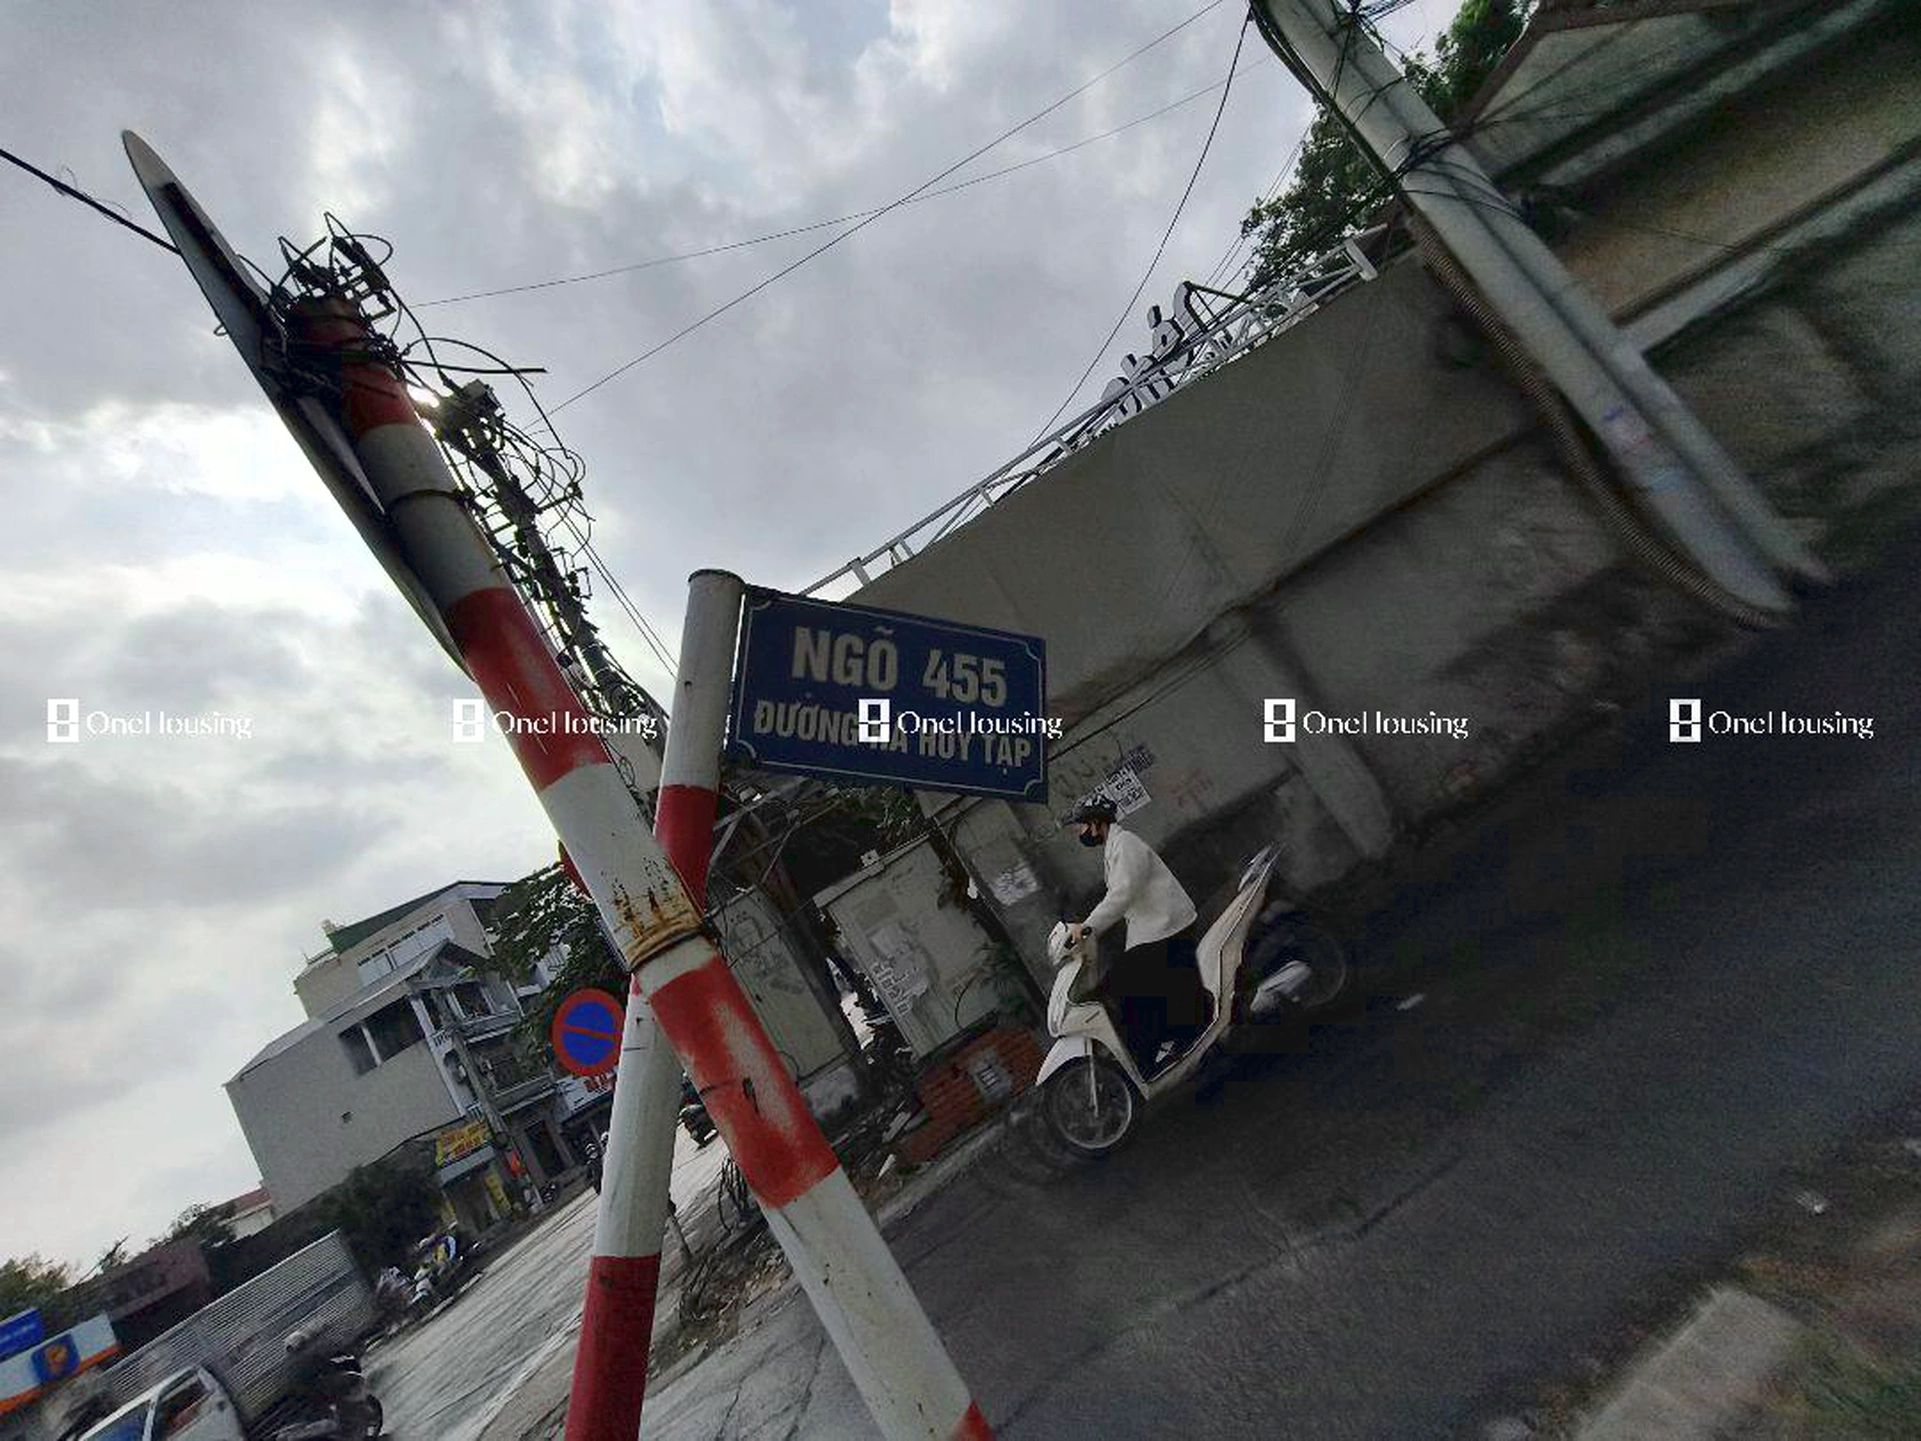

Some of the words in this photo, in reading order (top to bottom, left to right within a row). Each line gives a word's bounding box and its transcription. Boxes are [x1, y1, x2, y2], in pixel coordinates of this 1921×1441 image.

[791, 625, 898, 692] NGÕ
[921, 649, 1008, 708] 455
[919, 722, 971, 761] HUY
